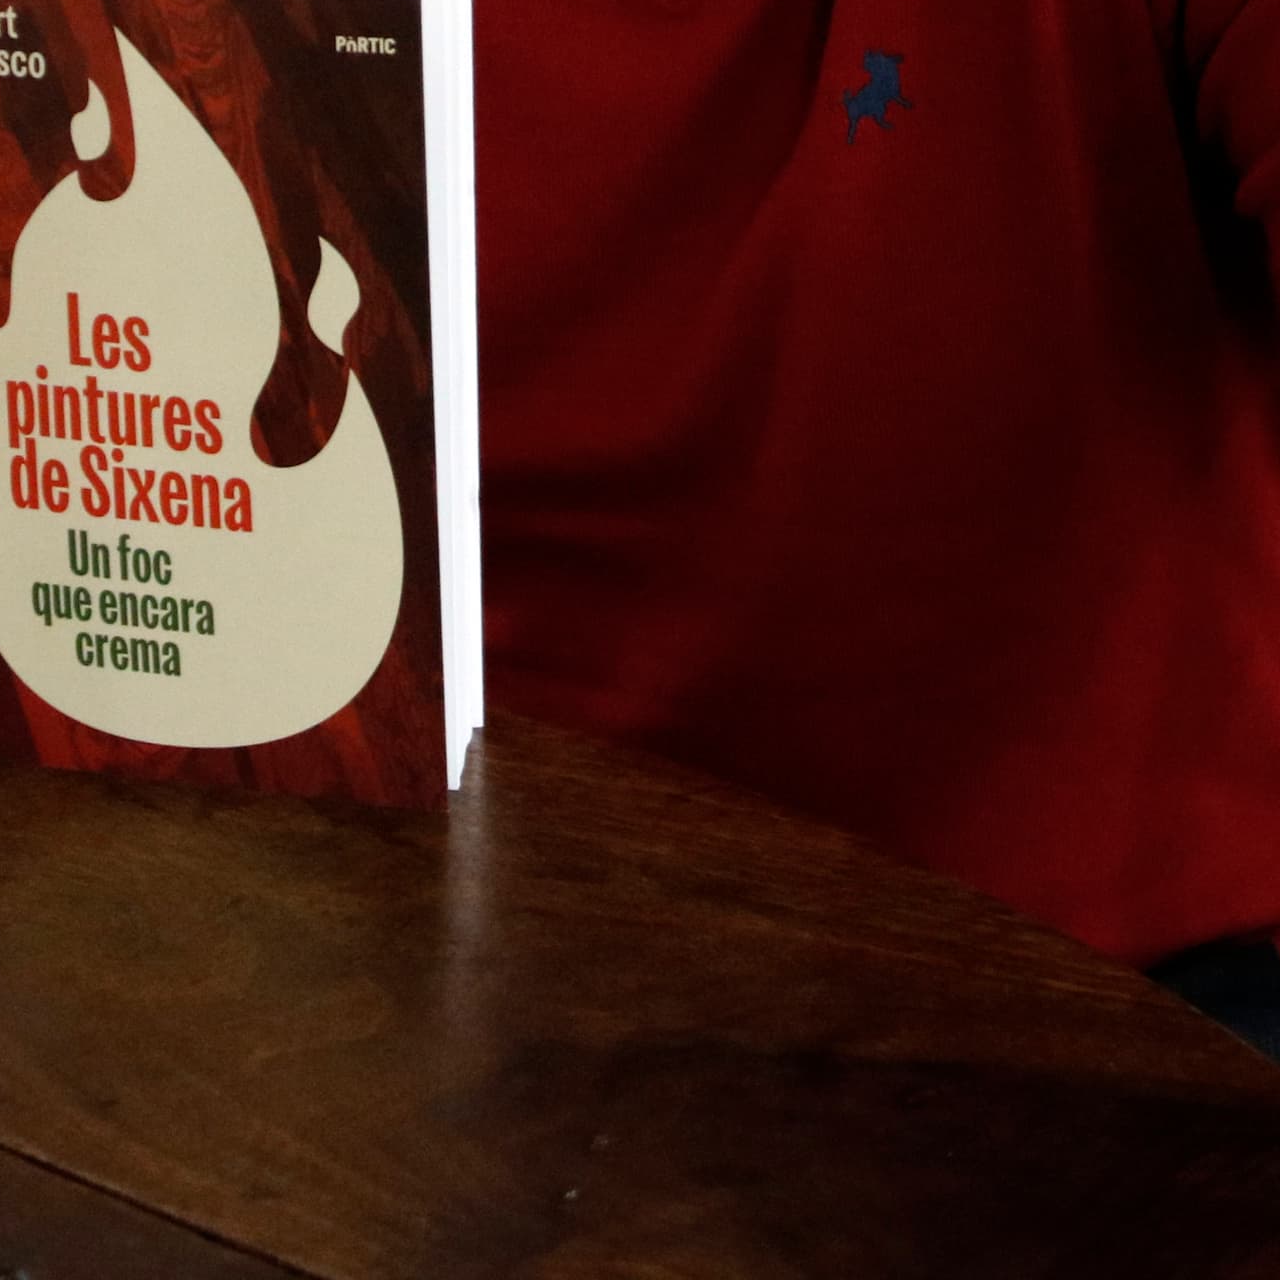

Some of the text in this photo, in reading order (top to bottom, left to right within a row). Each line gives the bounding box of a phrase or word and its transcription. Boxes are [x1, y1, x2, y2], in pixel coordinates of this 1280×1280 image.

[67, 292, 152, 372] Les
[6, 365, 222, 455] pintures
[10, 438, 253, 532] de Sixena
[68, 529, 173, 585] Un foc
[31, 581, 215, 635] que encara
[75, 631, 181, 676] crema
